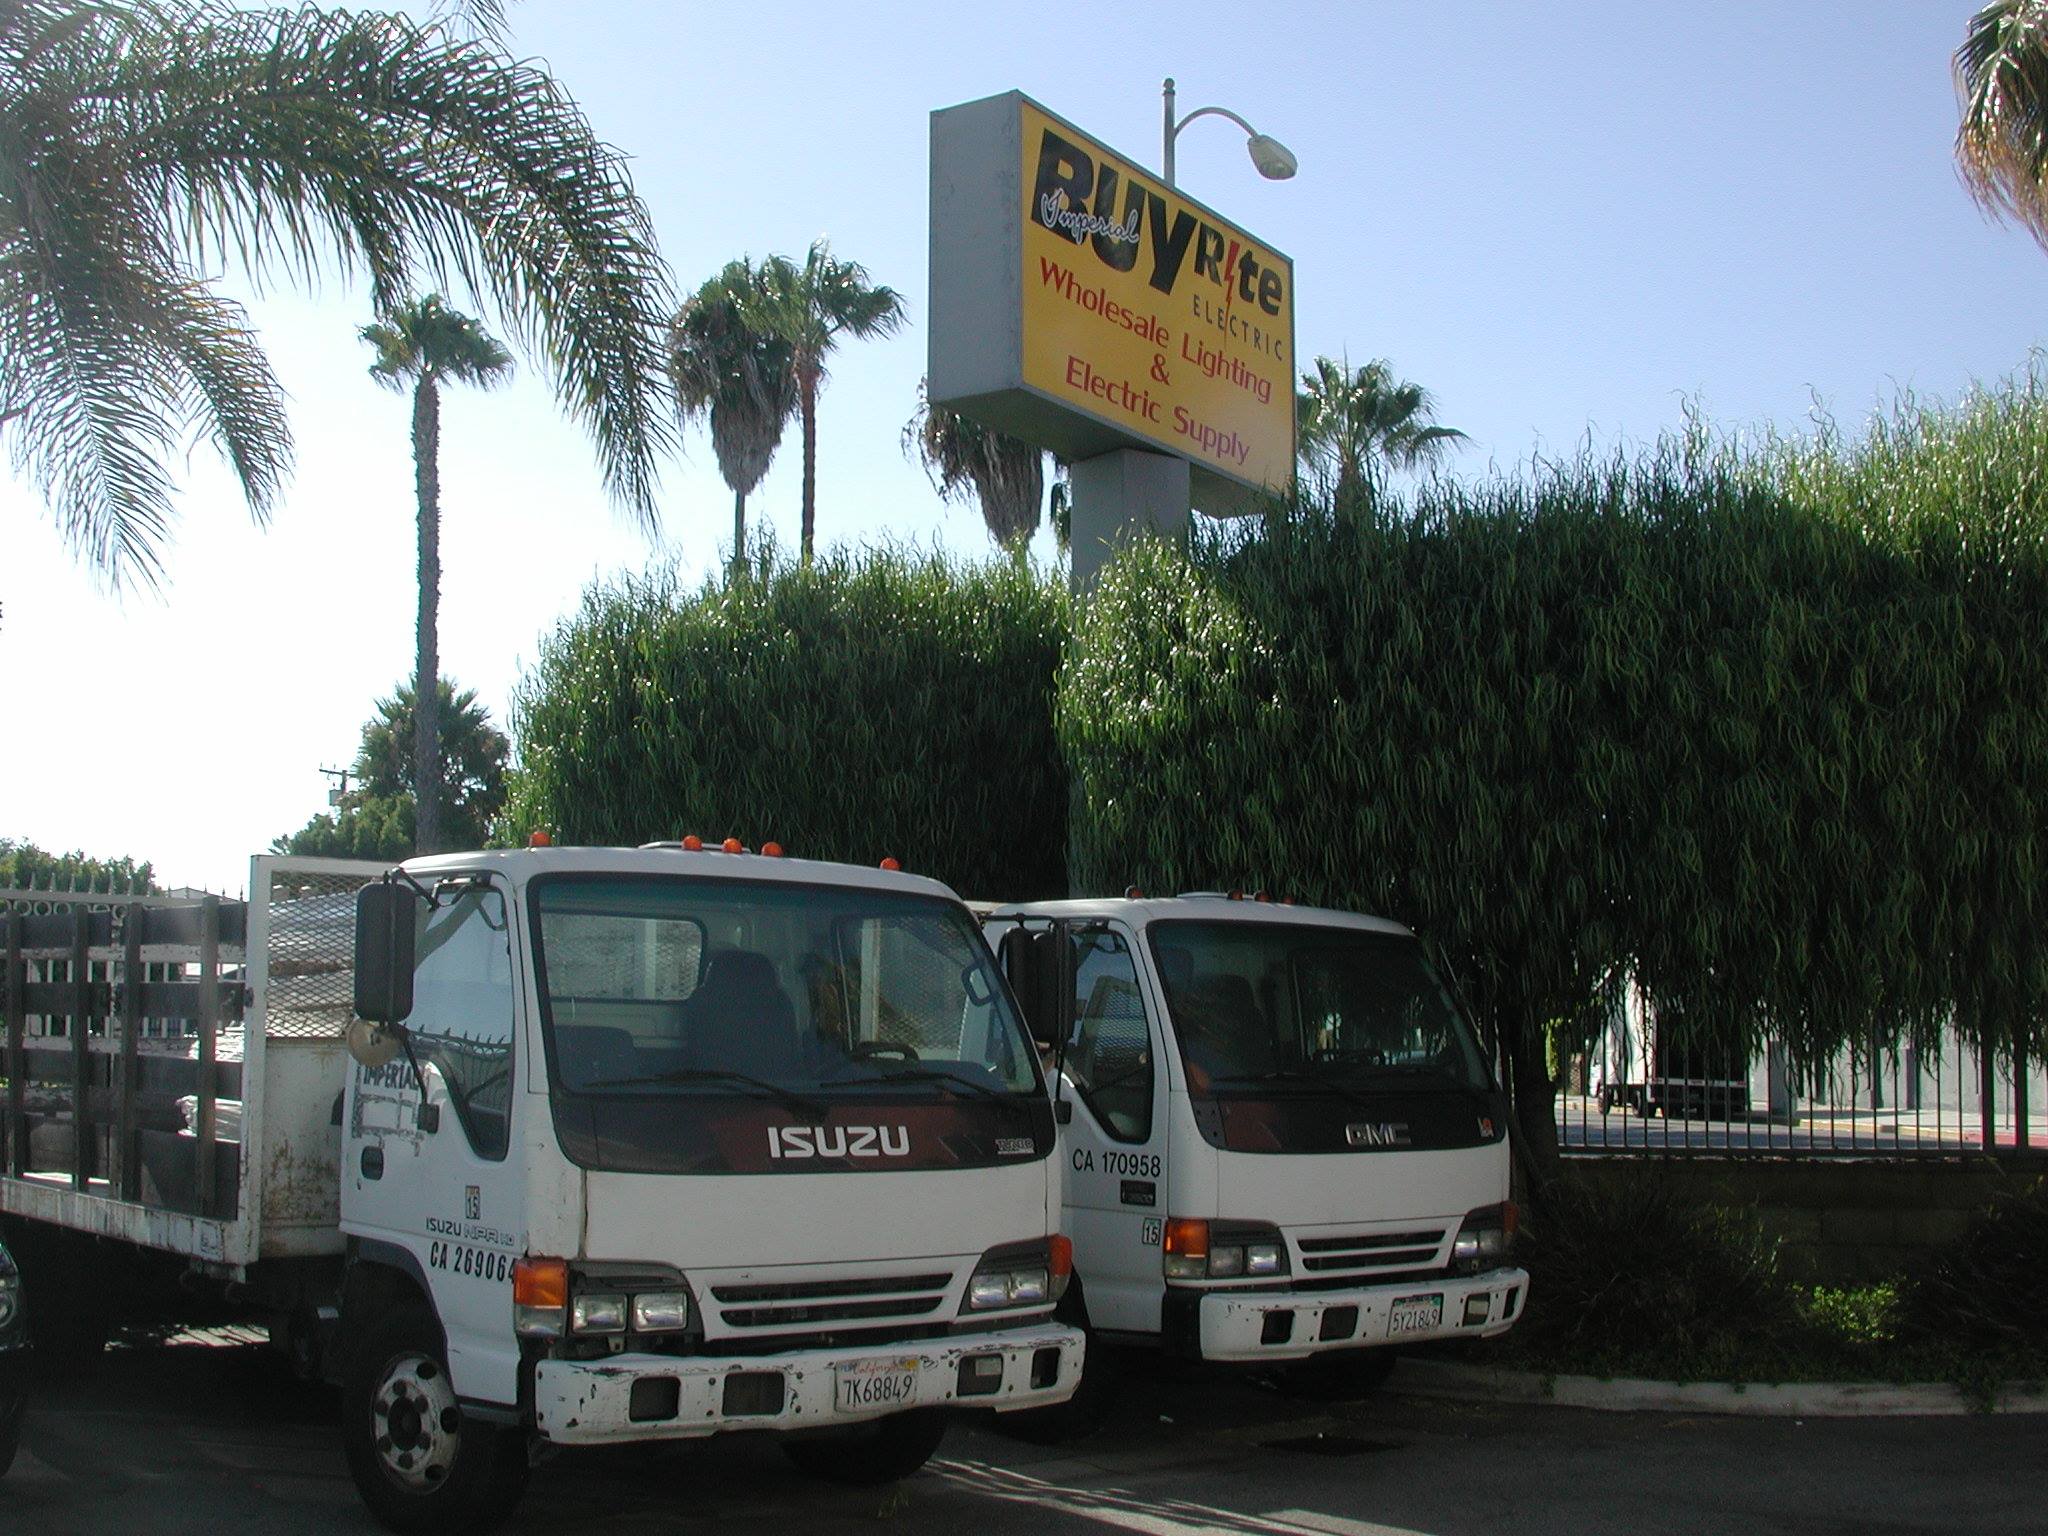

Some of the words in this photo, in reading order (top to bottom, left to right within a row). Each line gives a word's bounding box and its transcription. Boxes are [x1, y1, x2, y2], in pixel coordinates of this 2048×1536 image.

[1041, 188, 1140, 245] Imperial
[1040, 256, 1169, 348] Wholesale
[1181, 332, 1272, 405] Lighting
[1193, 294, 1283, 362] ELECTRIC
[1150, 353, 1171, 386] &
[1065, 354, 1162, 424] Electric
[1173, 405, 1250, 466] Supply
[767, 1125, 910, 1158] ISUZU
[1345, 1122, 1411, 1145] GMC
[1072, 1148, 1095, 1172] CA
[1102, 1151, 1161, 1178] 170958
[425, 1216, 462, 1237] ISUZU
[463, 1223, 499, 1244] NPR
[1145, 1225, 1159, 1244] 15
[430, 1241, 448, 1270] CA
[843, 1374, 913, 1406] 7K68849
